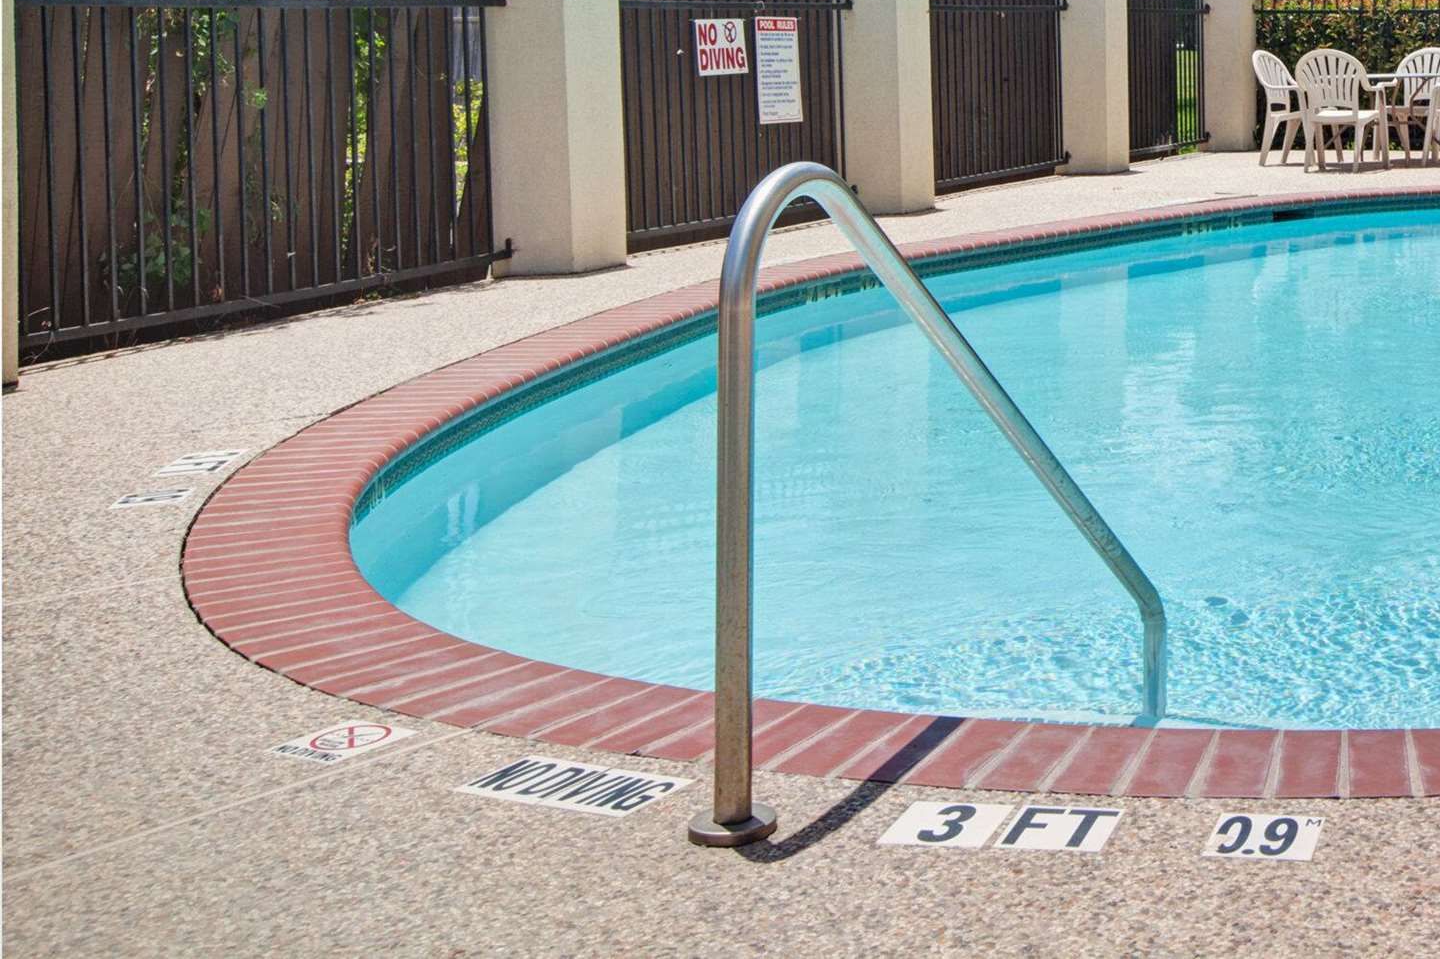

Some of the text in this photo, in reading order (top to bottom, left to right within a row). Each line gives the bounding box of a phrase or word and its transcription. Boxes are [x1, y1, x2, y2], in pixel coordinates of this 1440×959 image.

[698, 23, 717, 46] NO
[760, 20, 776, 30] POOL
[700, 47, 746, 71] DIVING
[467, 759, 676, 811] NO DIVING
[917, 804, 1119, 848] 3 FT
